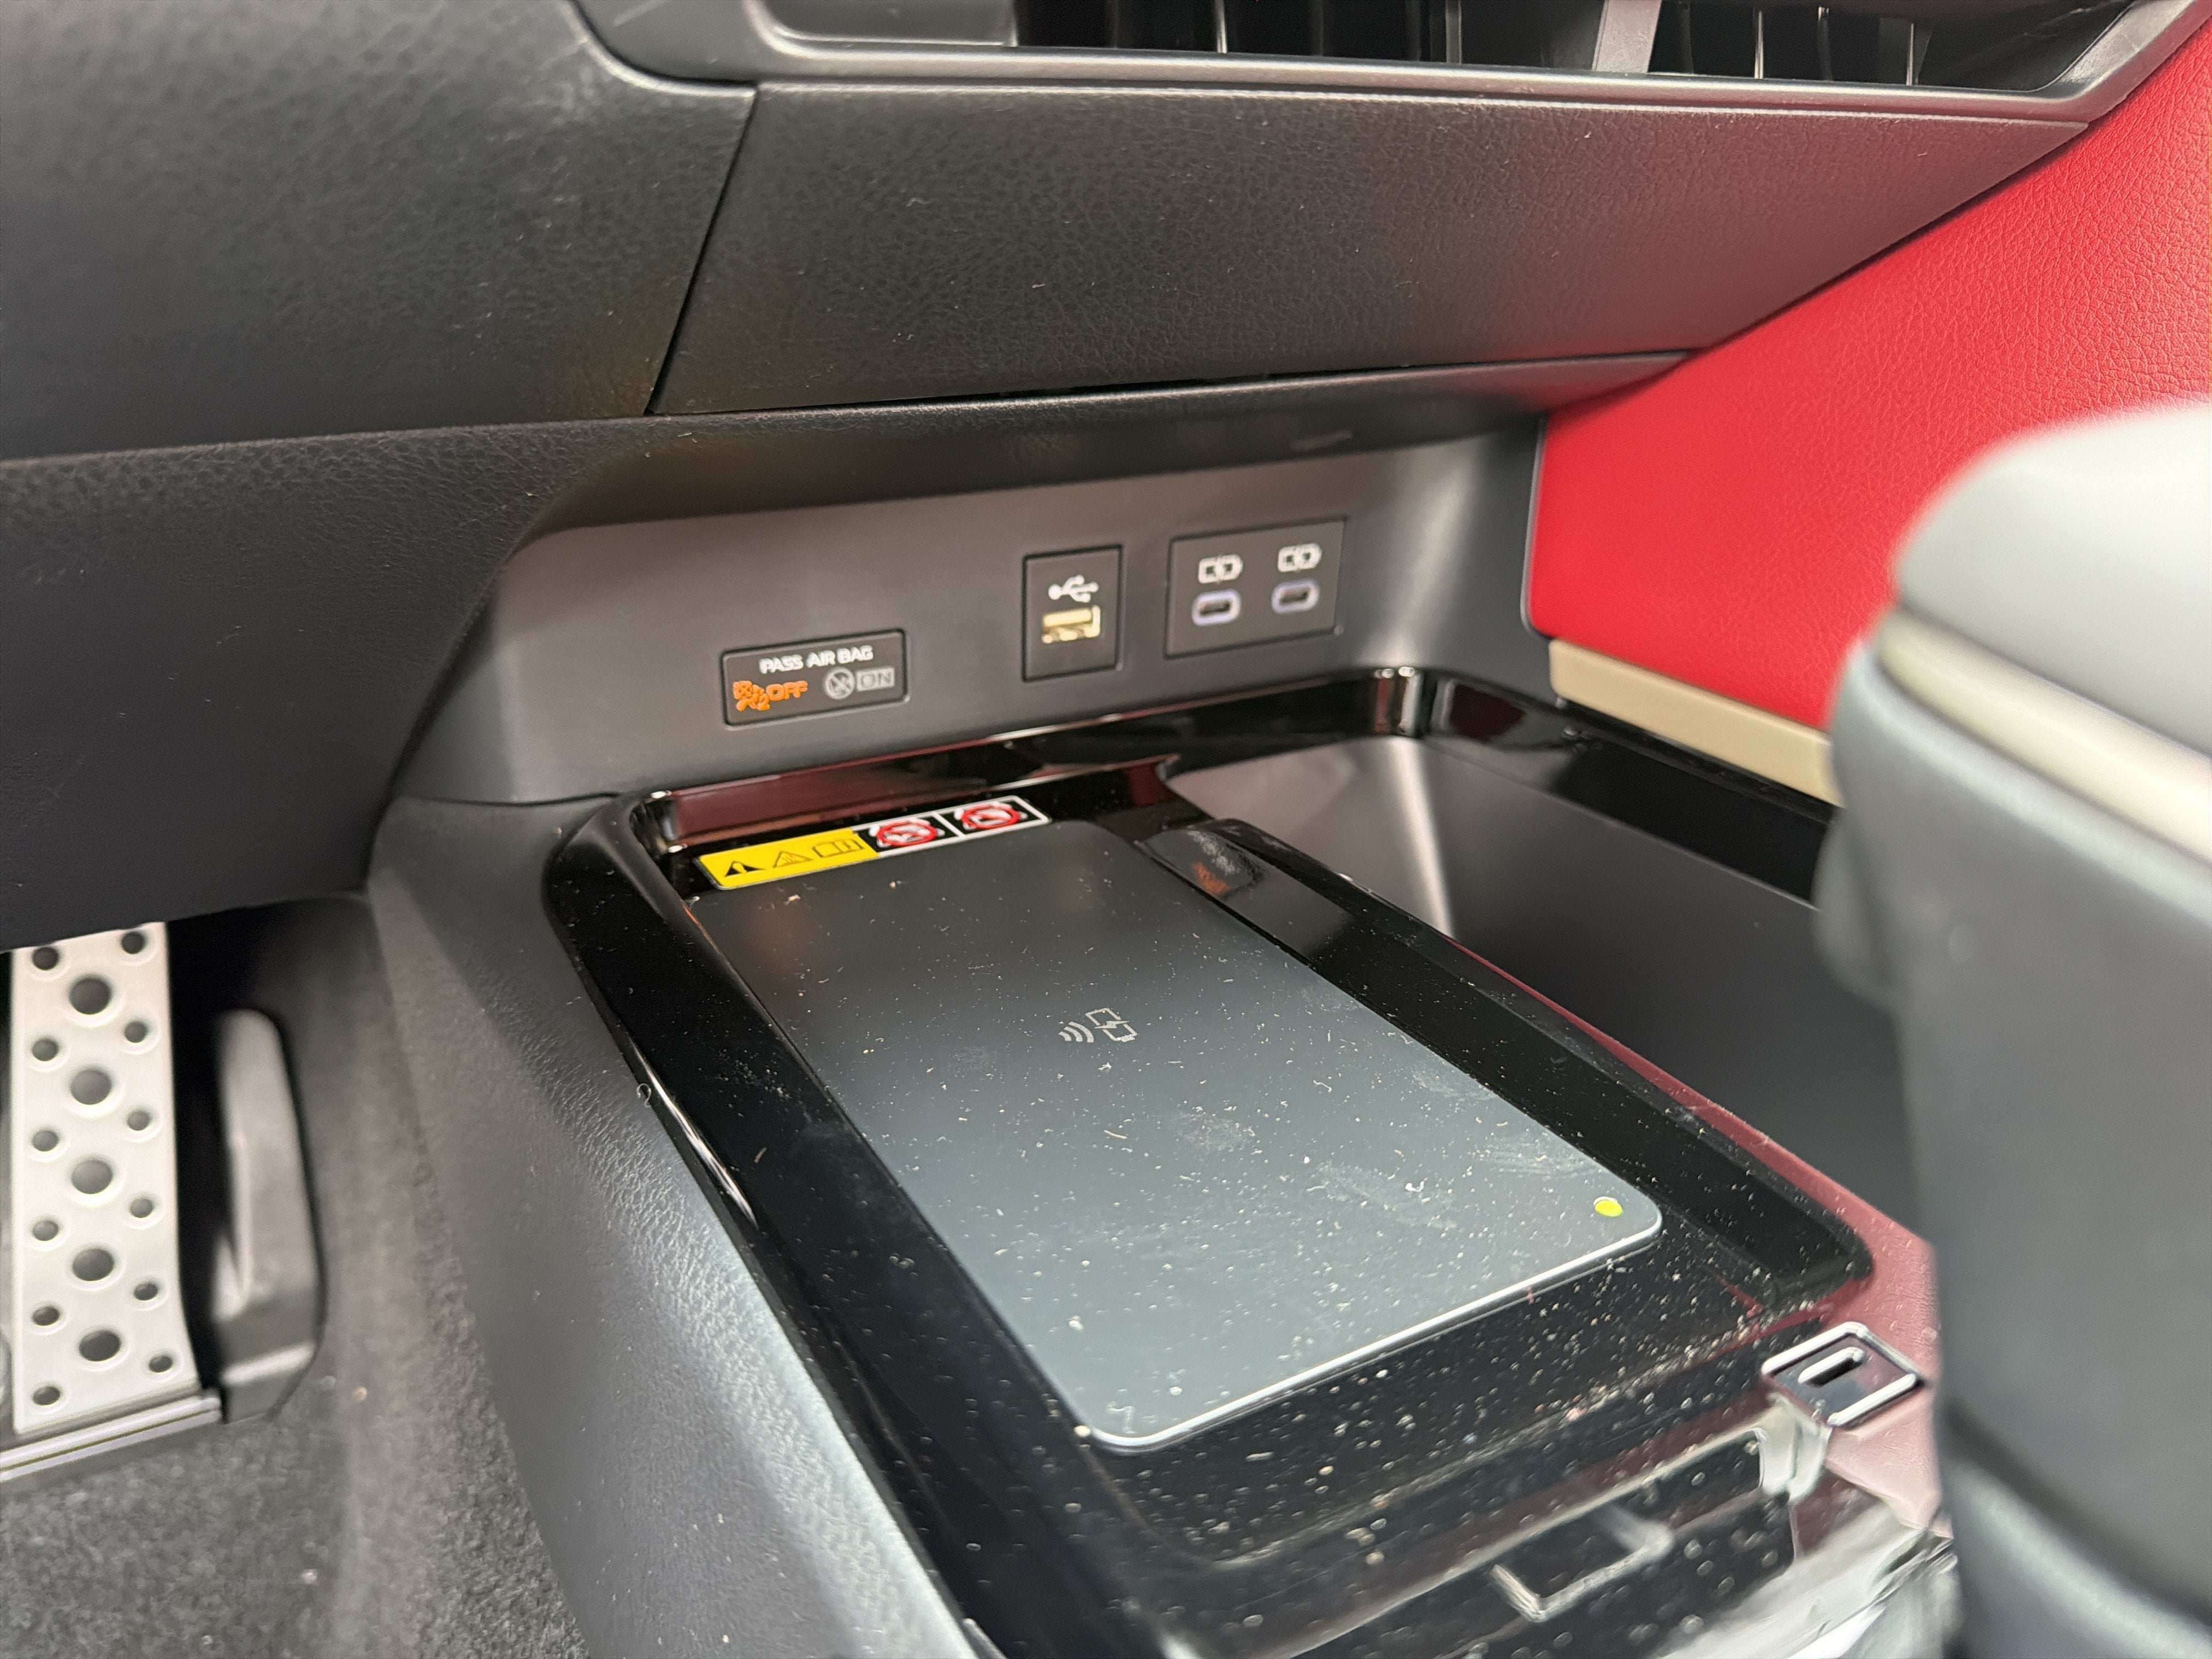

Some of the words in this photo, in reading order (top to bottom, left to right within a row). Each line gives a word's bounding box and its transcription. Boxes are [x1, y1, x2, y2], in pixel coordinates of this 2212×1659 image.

[759, 654, 803, 673] PASS
[806, 650, 836, 668] AIR
[837, 645, 873, 664] BAG
[859, 670, 893, 688] ON
[766, 680, 808, 701] OFF
